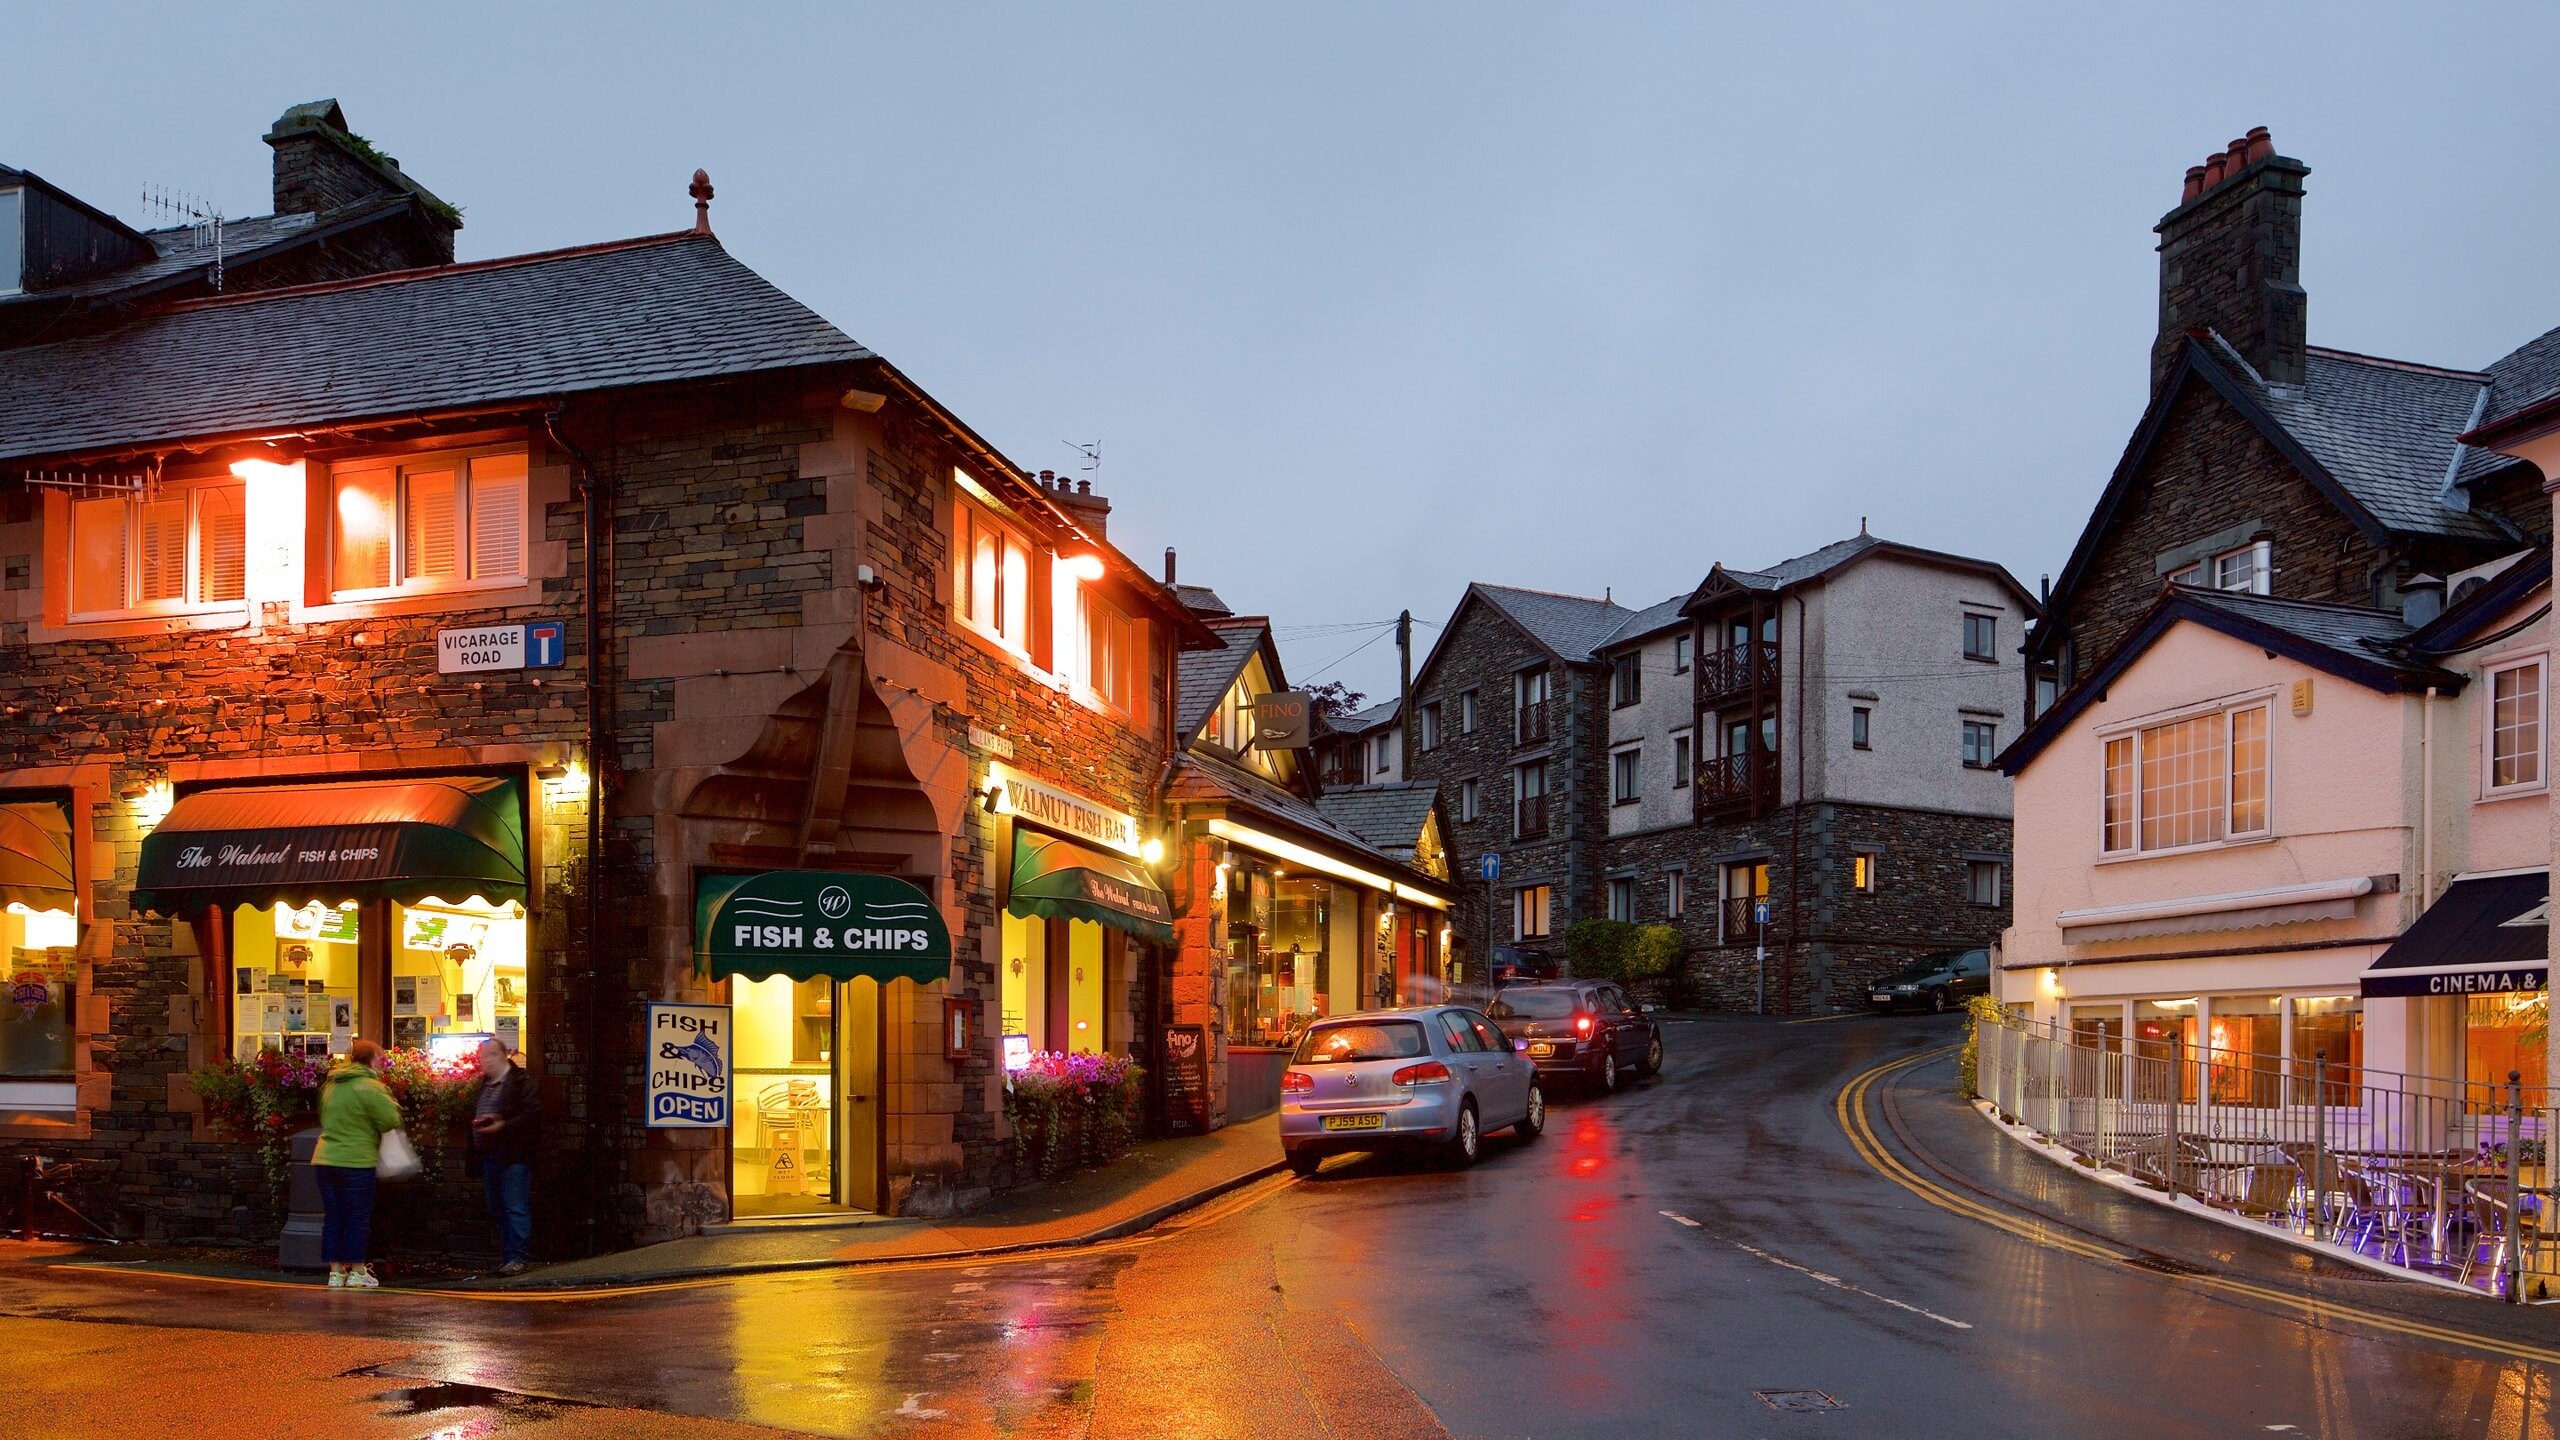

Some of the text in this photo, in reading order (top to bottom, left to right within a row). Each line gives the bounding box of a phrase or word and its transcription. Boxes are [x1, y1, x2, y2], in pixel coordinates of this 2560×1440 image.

[444, 631, 518, 649] VICARAGE
[461, 650, 501, 665] ROAD
[1261, 702, 1302, 718] FINO
[1006, 779, 1127, 844] WALNUT FISH BAR
[177, 843, 379, 868] The Walnut FISH & CHIPS
[1090, 880, 1105, 899] The
[1103, 884, 1130, 906] Walnut
[735, 925, 929, 950] FISH & CHIPS
[2430, 973, 2537, 993] CINEMA &
[657, 1013, 718, 1035] FISH
[660, 1042, 684, 1059] &
[652, 1070, 725, 1093] CHIPS
[659, 1096, 718, 1119] OPEN
[1329, 1117, 1355, 1127] PJ59
